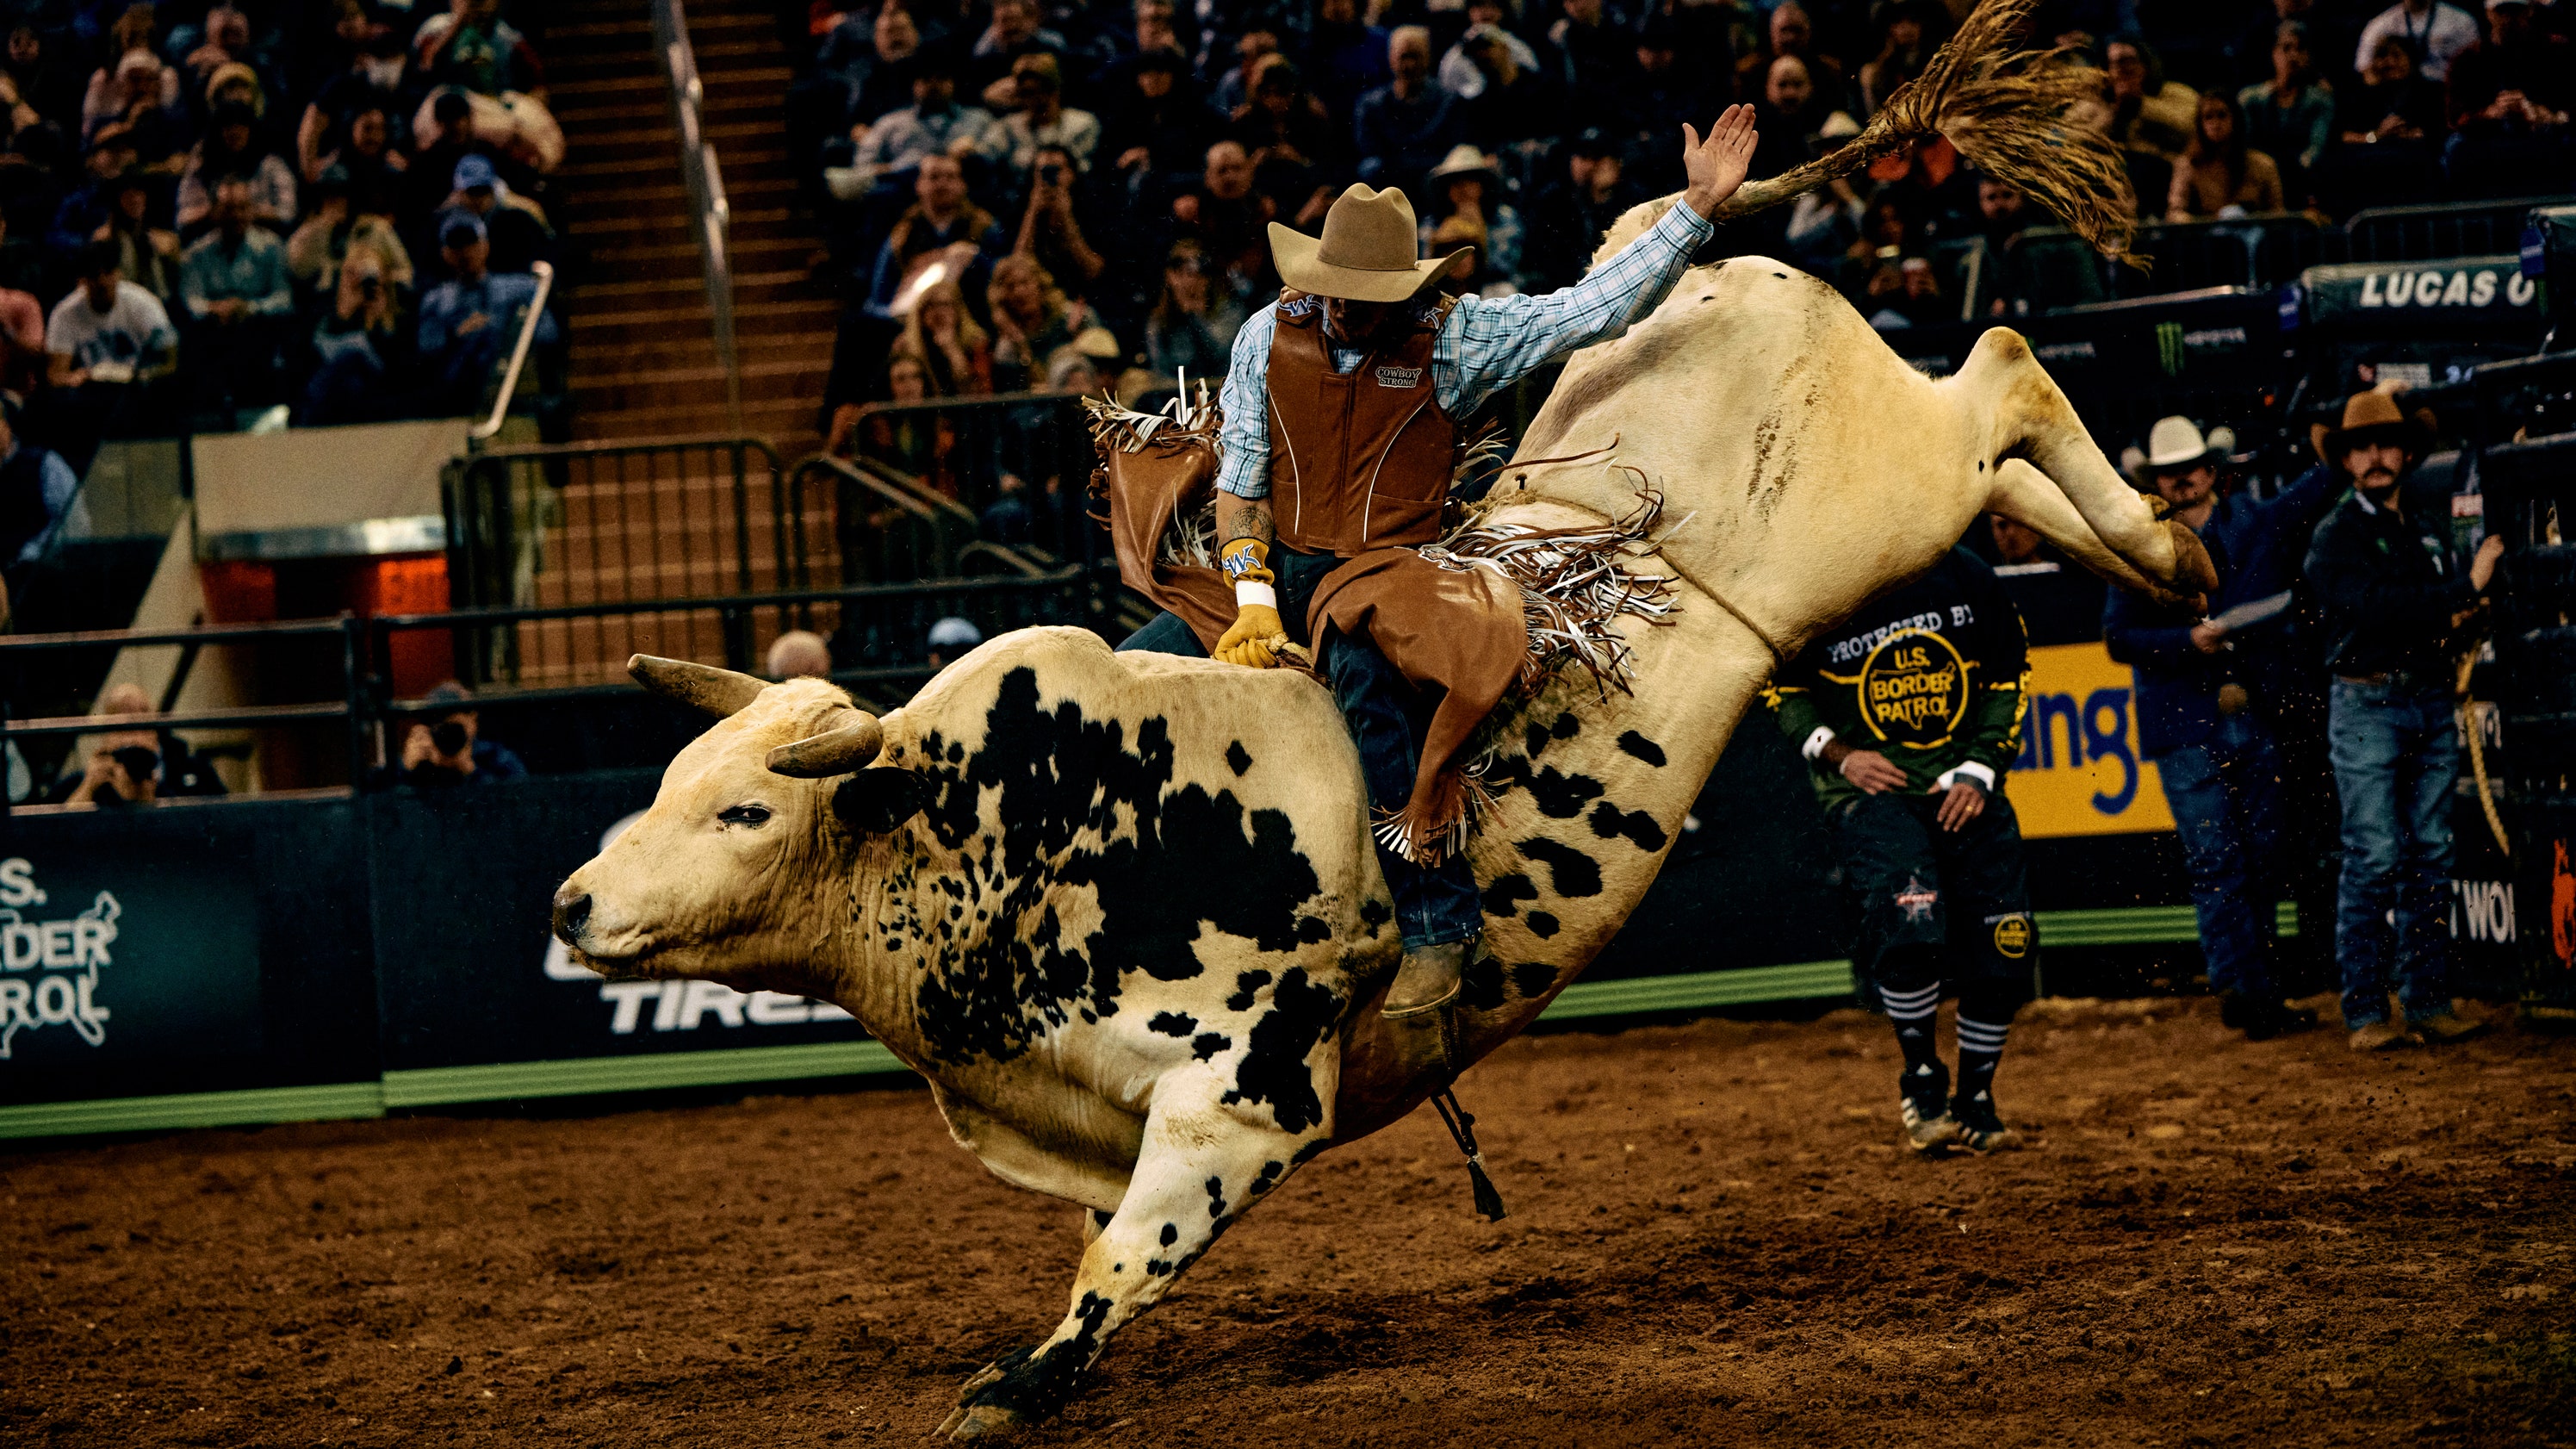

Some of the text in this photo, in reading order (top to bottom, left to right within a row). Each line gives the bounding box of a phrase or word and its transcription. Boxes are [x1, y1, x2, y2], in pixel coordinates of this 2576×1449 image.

[2359, 270, 2498, 308] LUCAS
[1377, 368, 1420, 379] COWBOY
[1380, 377, 1415, 386] STRONG
[1895, 647, 1931, 669] U.S.
[1872, 672, 1952, 701] BORDER
[1876, 696, 1951, 724] PATROL
